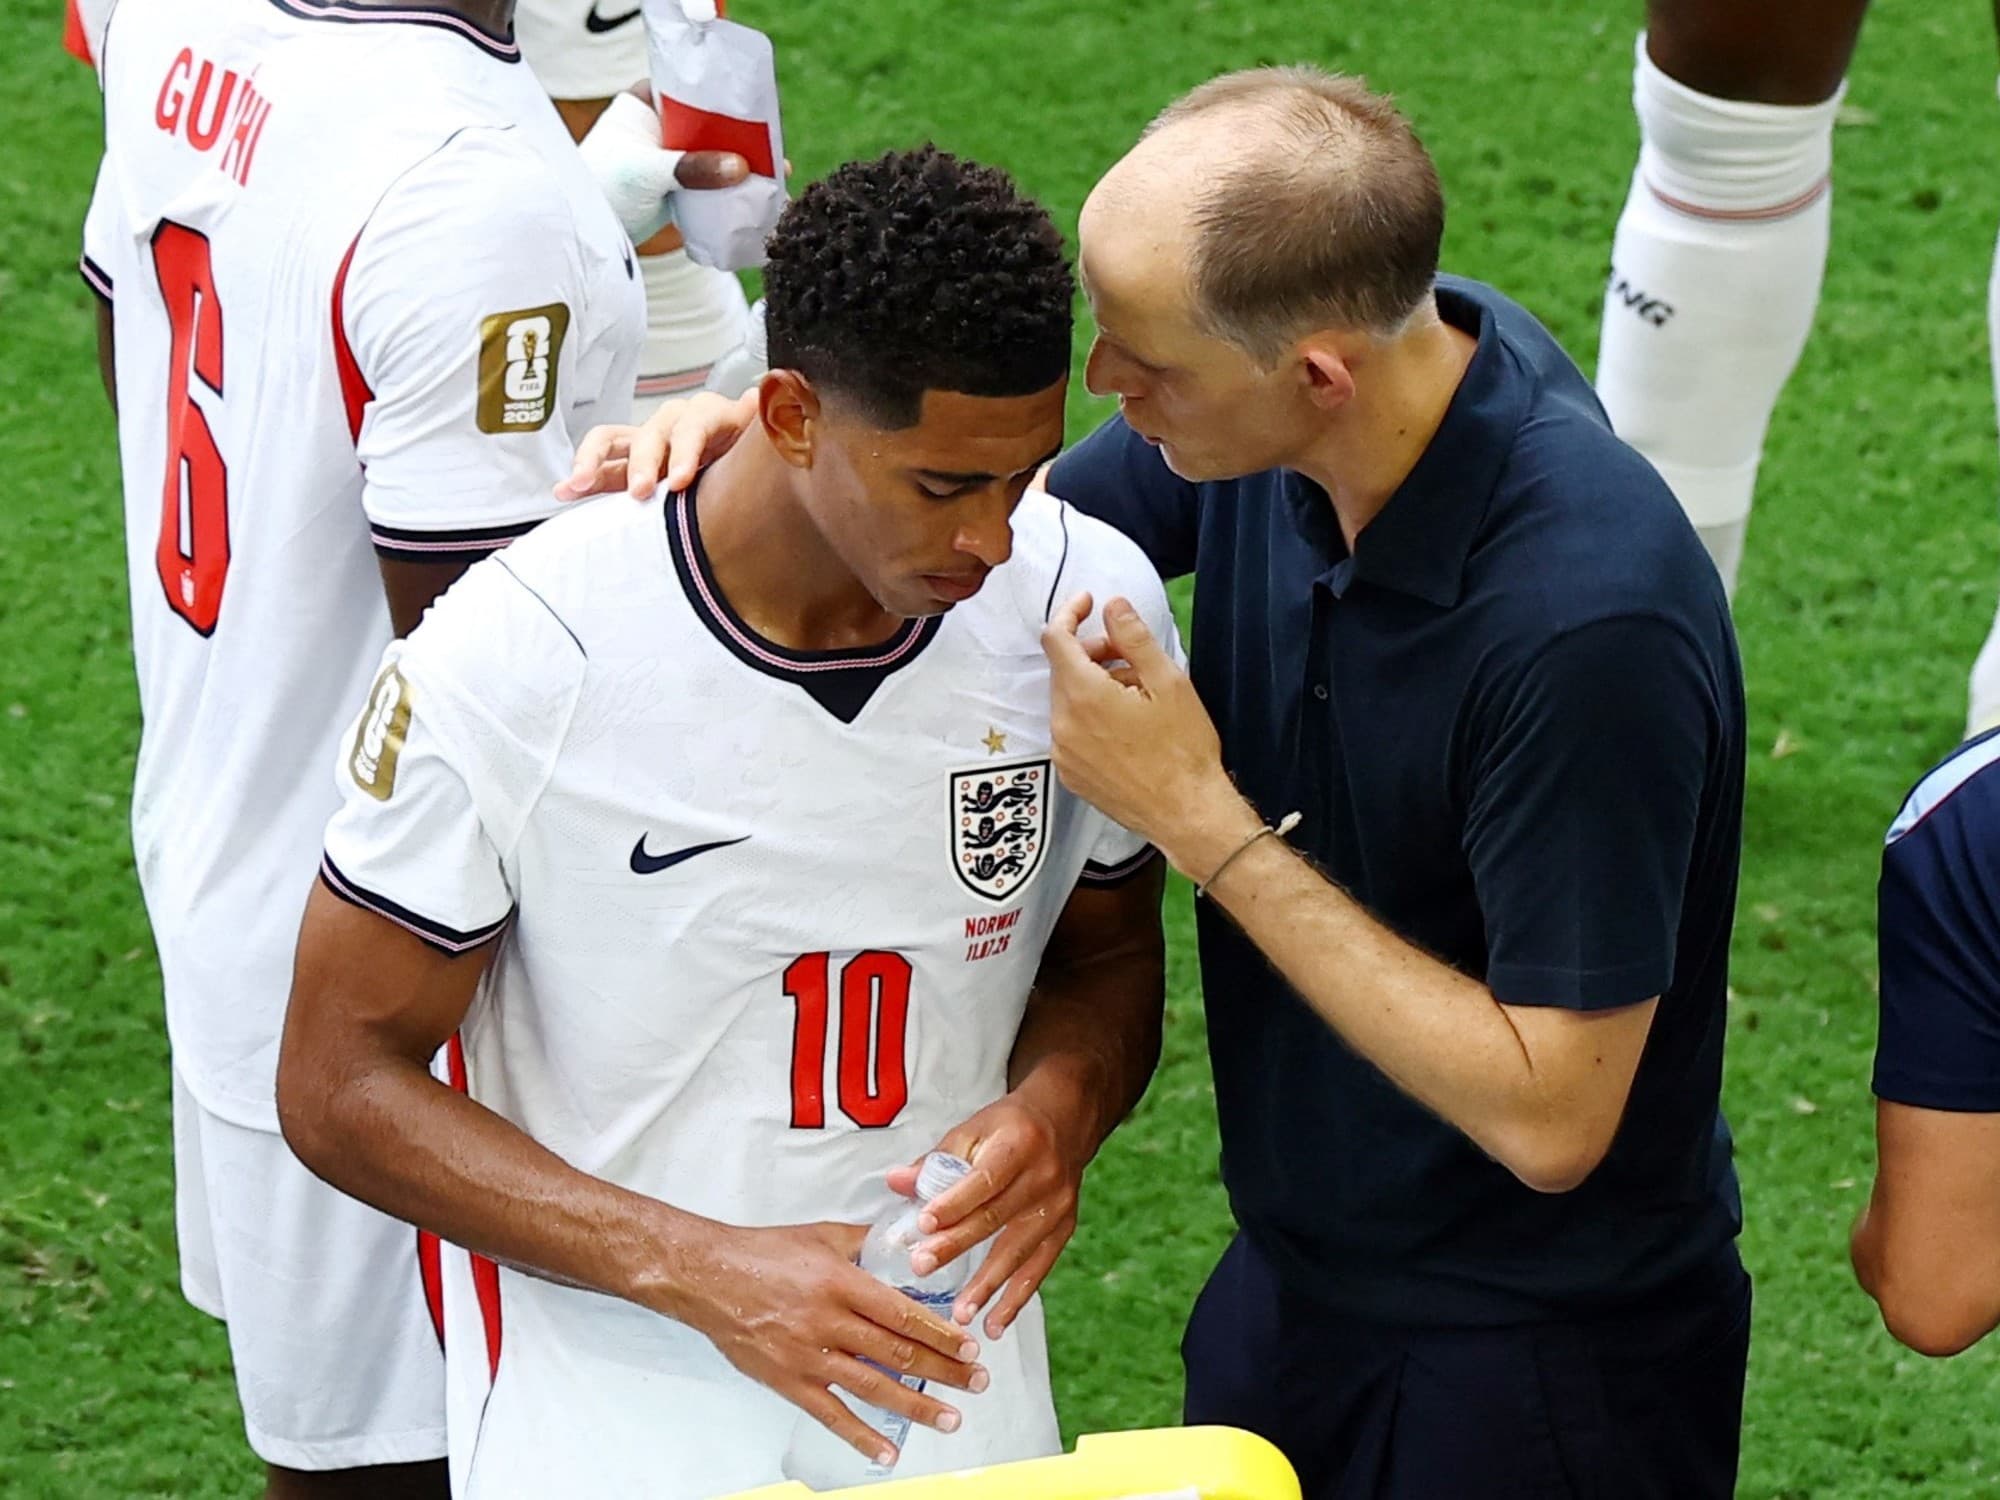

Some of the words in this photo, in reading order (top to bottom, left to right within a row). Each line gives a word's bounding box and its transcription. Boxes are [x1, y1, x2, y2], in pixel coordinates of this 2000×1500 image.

[155, 46, 273, 188] GUHI
[1608, 264, 1675, 329] NG
[151, 217, 231, 639] 6
[964, 906, 1024, 939] NORWAY
[783, 949, 913, 1129] 10
